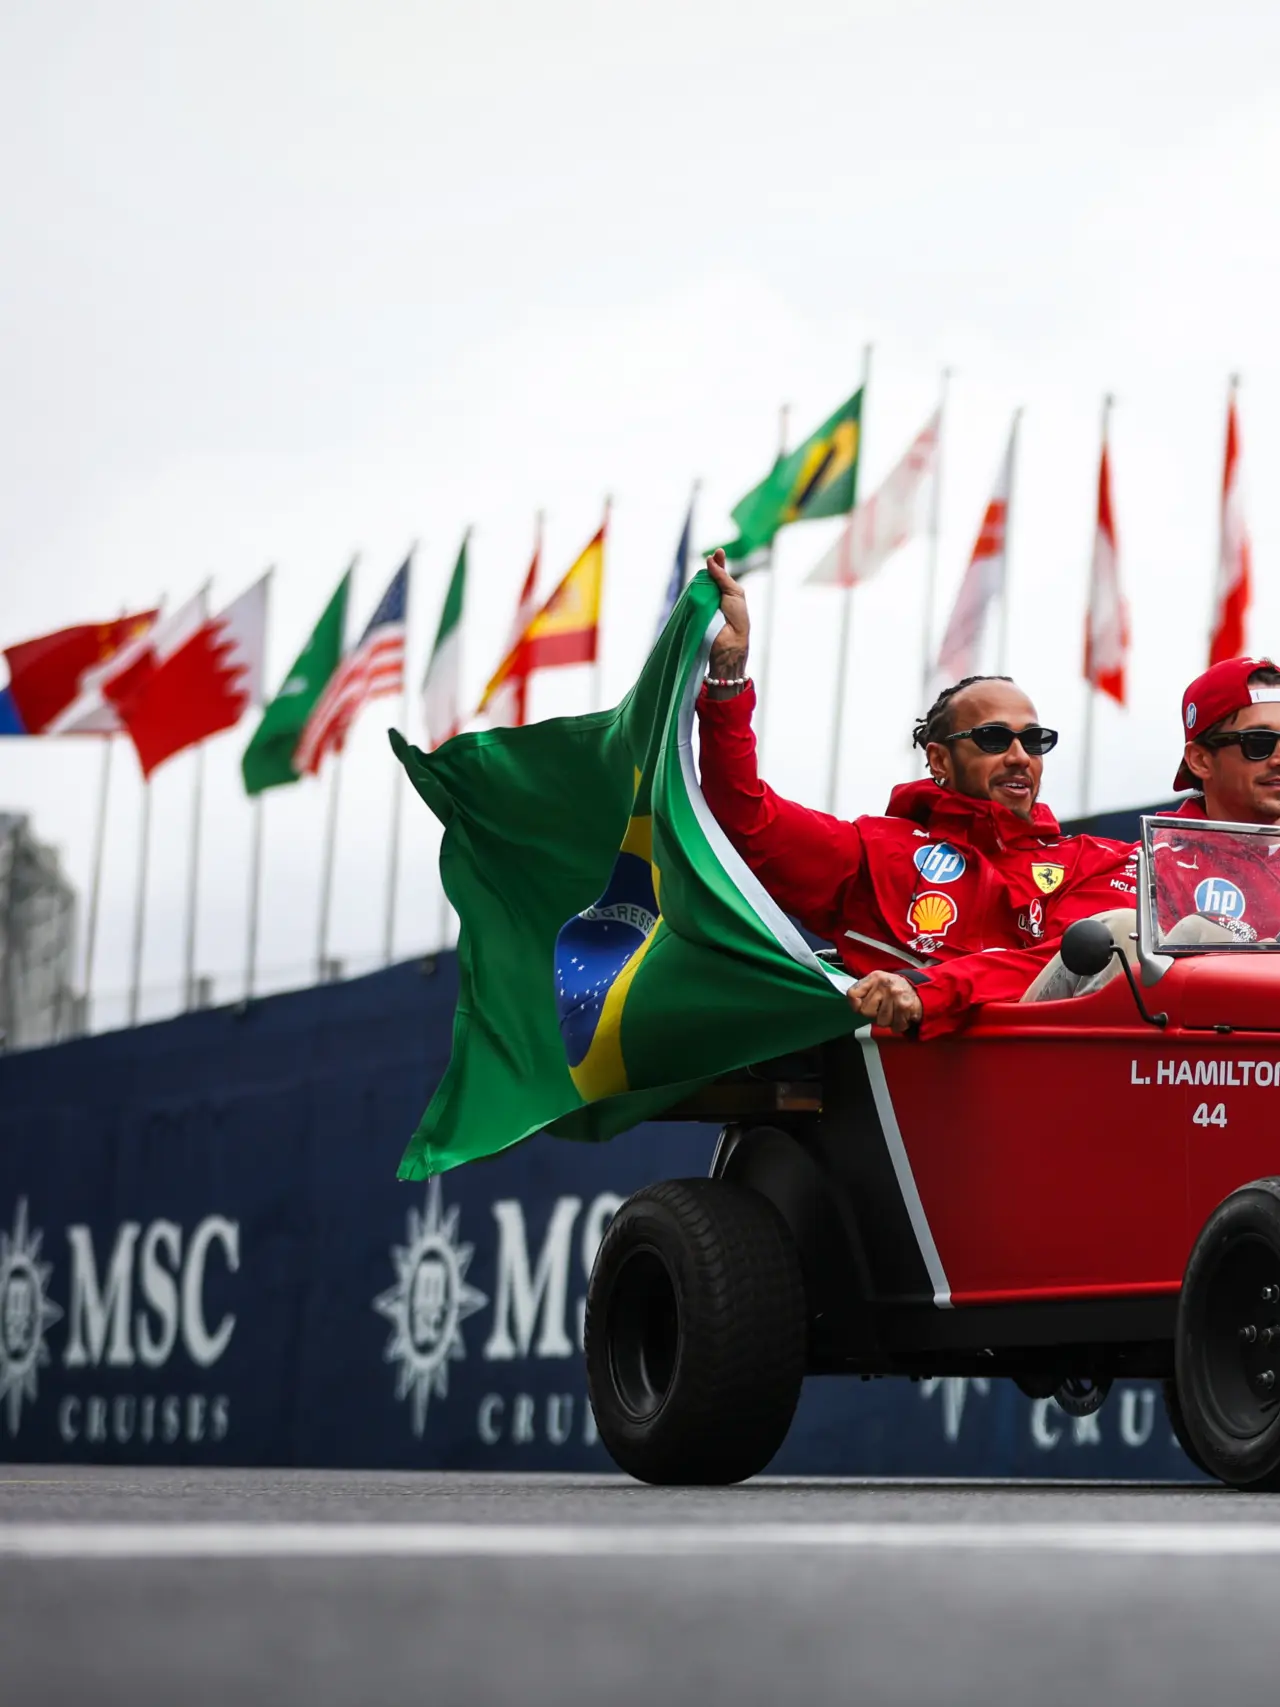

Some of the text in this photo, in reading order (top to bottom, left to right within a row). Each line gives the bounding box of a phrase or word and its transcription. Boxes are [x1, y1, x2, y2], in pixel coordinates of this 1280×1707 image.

[920, 843, 960, 882] hp
[1110, 879, 1137, 894] HCLS
[1203, 878, 1238, 915] hp
[582, 905, 656, 934] OGRESS
[1131, 1060, 1151, 1085] L.
[1192, 1103, 1228, 1128] 44
[64, 1215, 240, 1368] MSC
[57, 1394, 230, 1445] CRUISES
